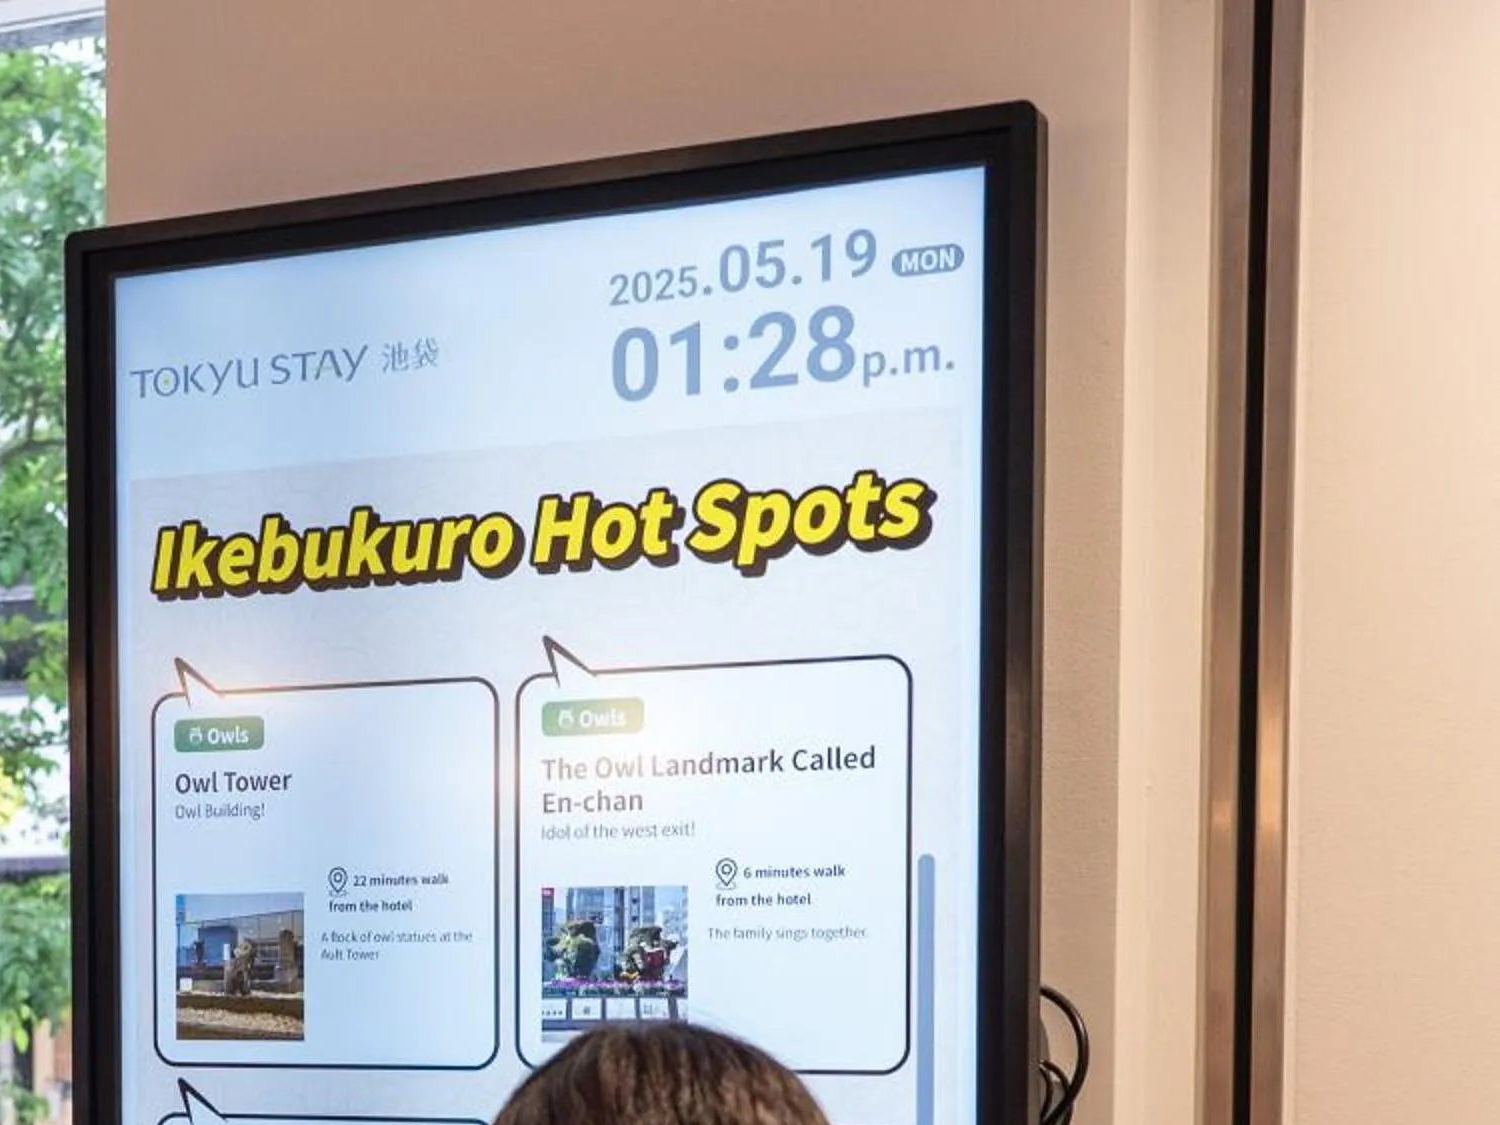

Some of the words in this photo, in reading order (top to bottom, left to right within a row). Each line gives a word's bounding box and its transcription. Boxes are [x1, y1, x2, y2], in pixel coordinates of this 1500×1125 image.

[609, 229, 878, 306] 2025.05.19
[899, 246, 957, 275] MON
[132, 356, 259, 400] TOKYU
[270, 343, 368, 386] STAY
[381, 338, 439, 375] 池袋
[151, 505, 525, 601] Ikebukuro
[531, 487, 684, 576] Hot
[688, 469, 937, 577] Spots
[579, 707, 627, 728] Owls
[207, 725, 250, 746] Owls
[542, 757, 587, 782] The
[595, 755, 643, 779] Owl
[651, 749, 784, 778] Landmark
[792, 745, 876, 772] Called
[175, 772, 217, 795] Owl
[224, 770, 293, 793] Tower
[175, 803, 201, 820] Owl
[205, 802, 266, 820] Building!
[542, 790, 644, 815] En-chan
[541, 824, 571, 841] Idol
[574, 823, 589, 840] of
[593, 823, 618, 840] the
[621, 823, 658, 838] west
[662, 821, 696, 838] exit!
[353, 874, 367, 887] 22
[369, 873, 419, 887] minutes
[421, 872, 449, 885] walk
[743, 866, 752, 879] 6
[755, 865, 811, 879] minutes
[813, 864, 846, 877] walk
[329, 900, 358, 913] from
[360, 900, 379, 912] the
[381, 900, 413, 912] hotel
[715, 893, 748, 907] from
[751, 892, 774, 907] the
[777, 891, 812, 906] hotel
[374, 931, 395, 943] owl
[397, 931, 436, 943] statues
[708, 927, 731, 941] The
[733, 926, 773, 942] family
[775, 927, 808, 943] sings
